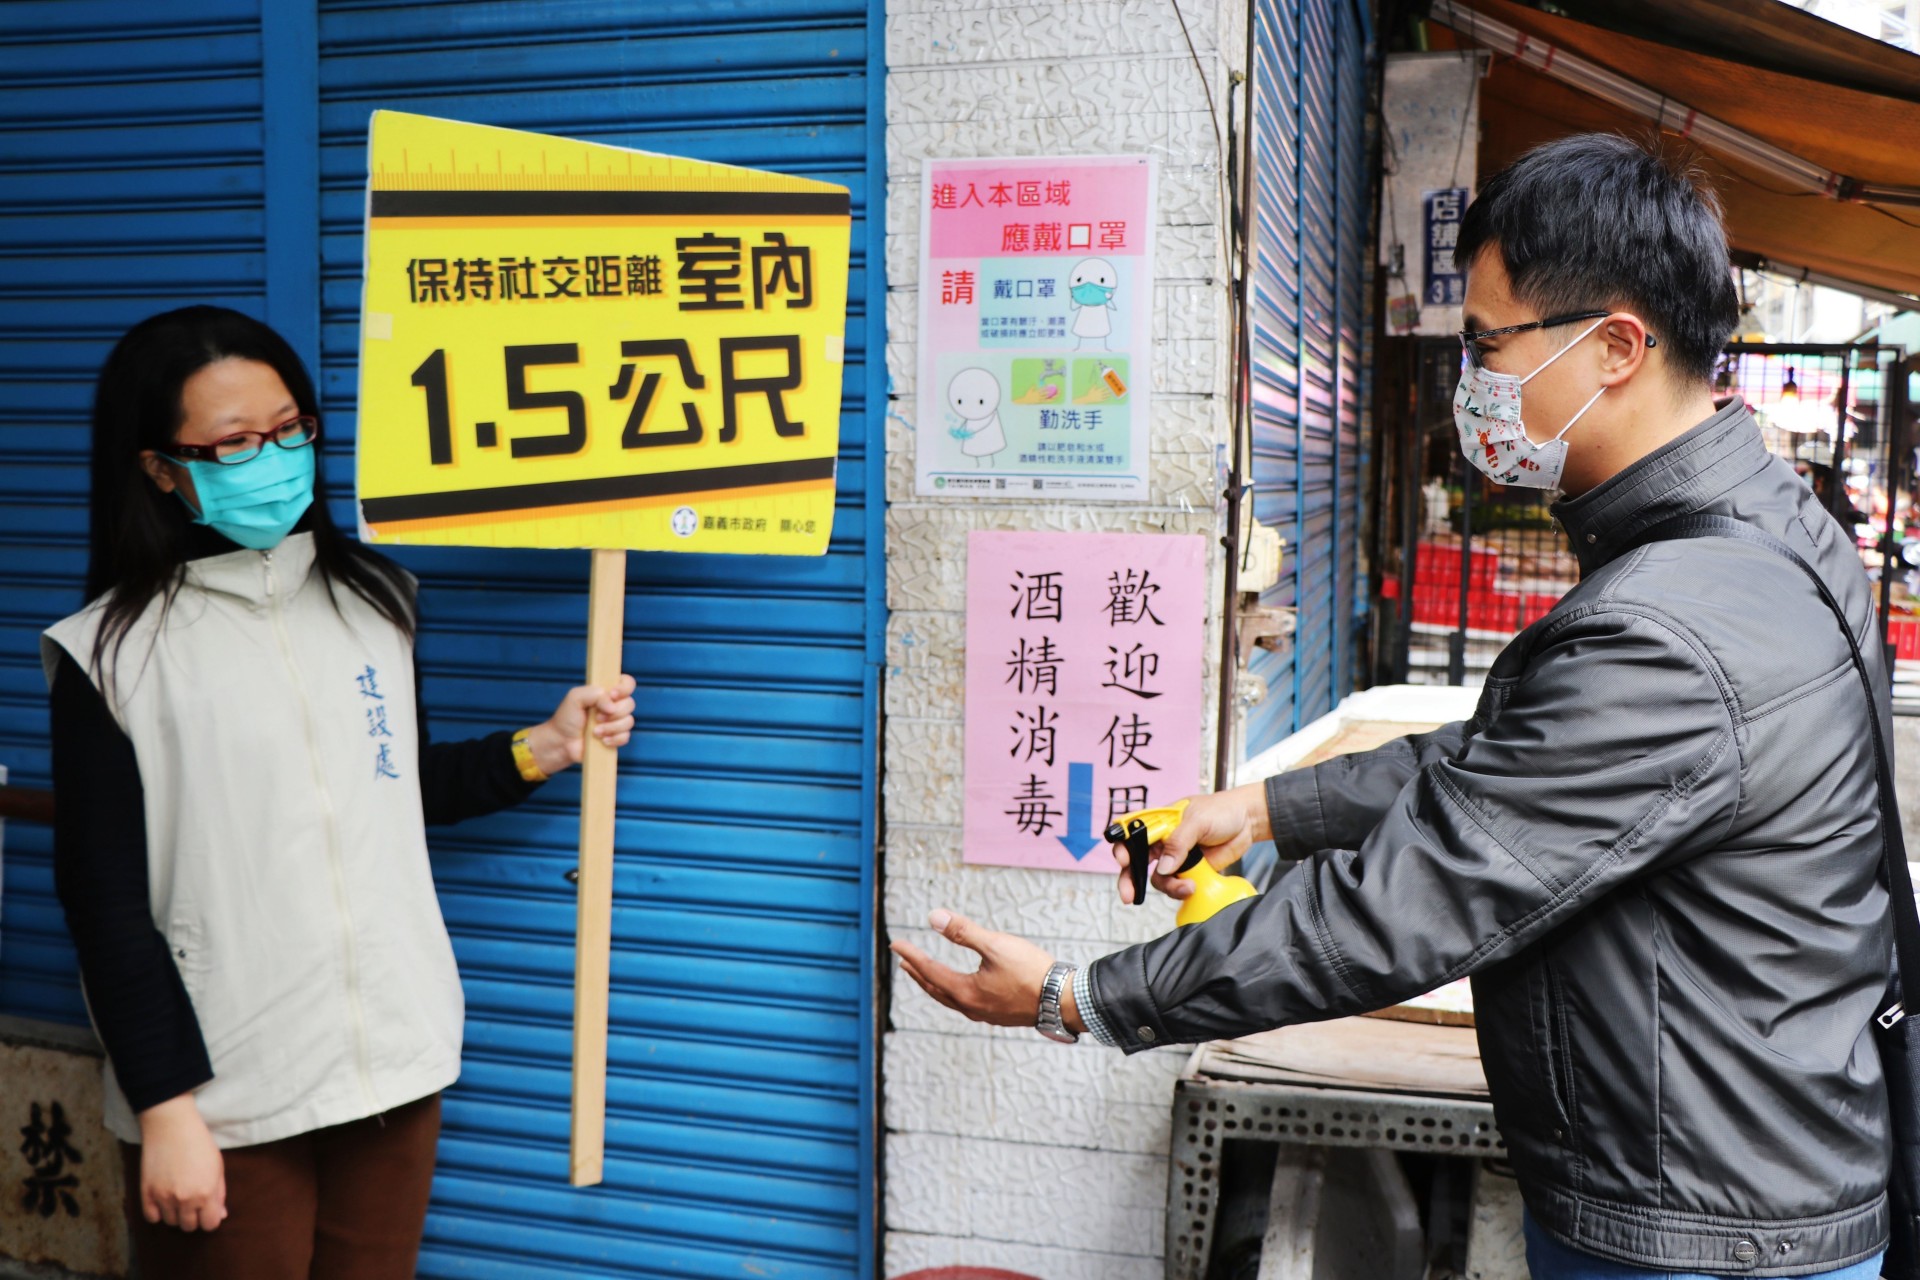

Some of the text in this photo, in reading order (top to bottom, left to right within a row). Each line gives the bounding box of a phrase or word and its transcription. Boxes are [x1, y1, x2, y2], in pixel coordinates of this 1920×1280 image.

[931, 180, 1071, 210] 進入本區域
[1001, 221, 1127, 252] 應戴口罩
[406, 231, 813, 312] 保持社交距離 室內
[941, 270, 975, 305] 請
[993, 278, 1056, 300] 戴口罩
[410, 334, 806, 466] 1.5公尺
[1039, 408, 1104, 431] 勤洗手
[703, 515, 816, 534] 嘉義市政府 關心您
[1004, 570, 1065, 837] 酒精消毒
[356, 664, 401, 781] 建設處
